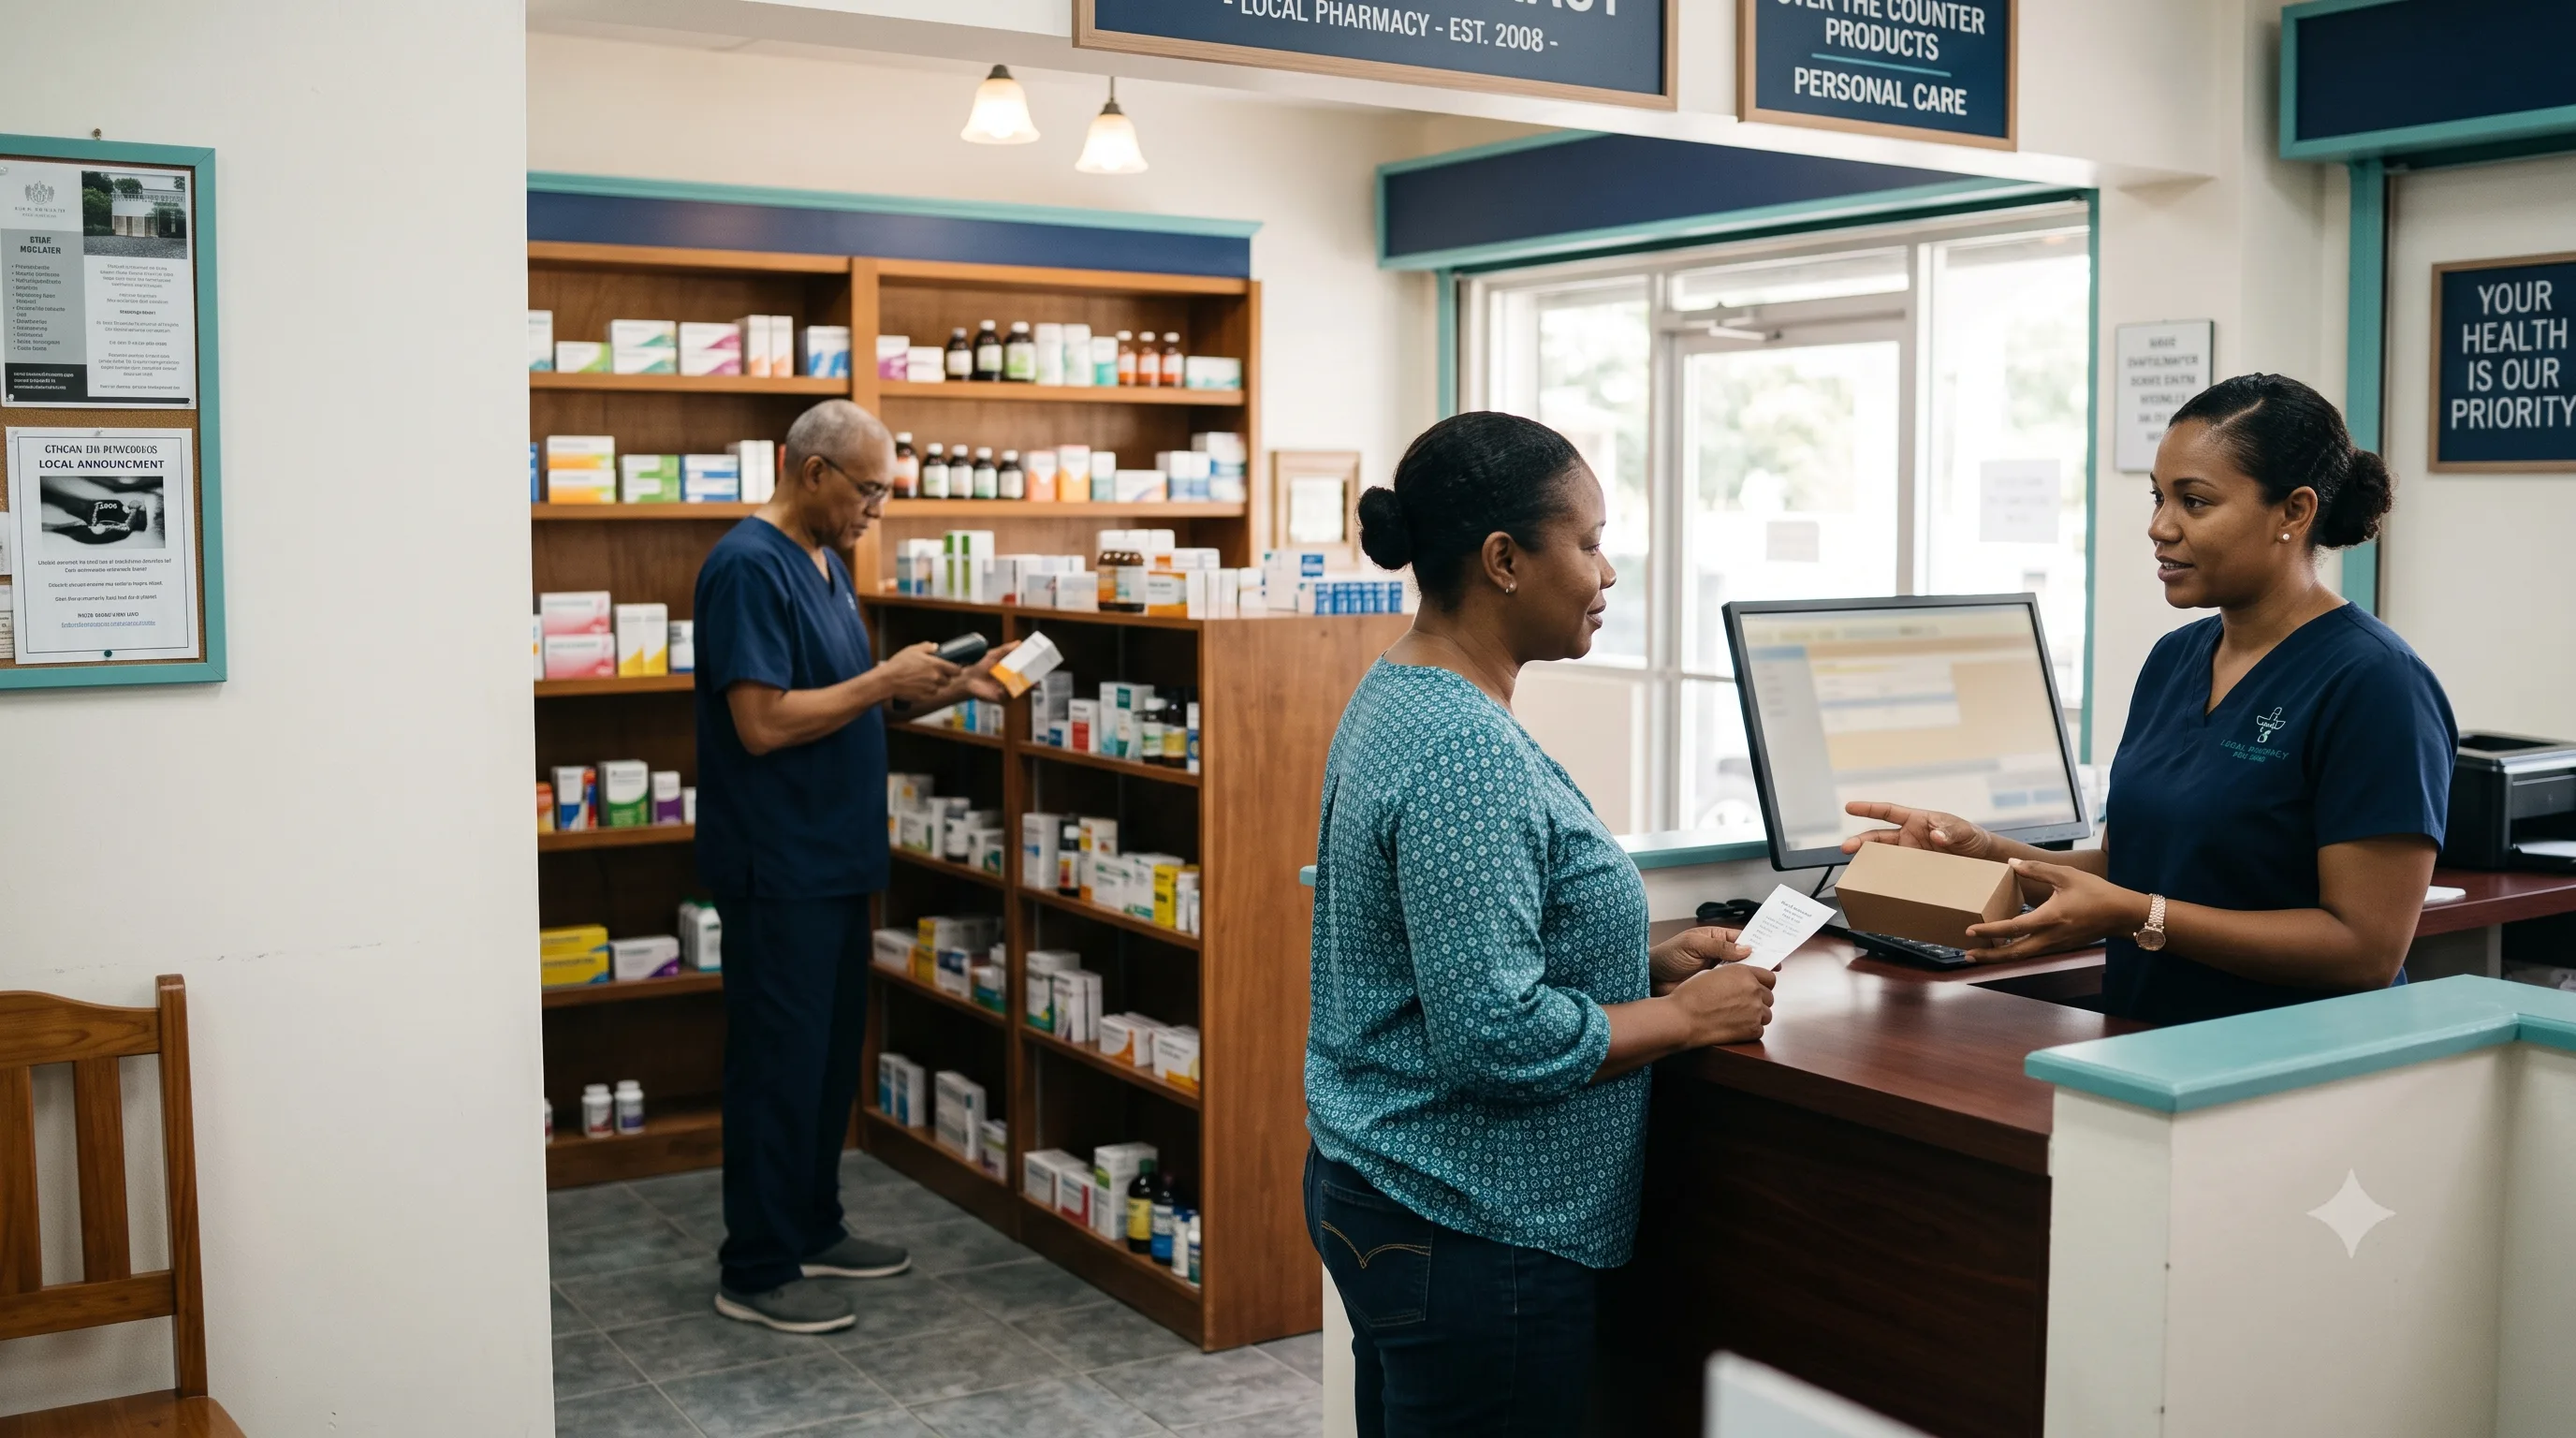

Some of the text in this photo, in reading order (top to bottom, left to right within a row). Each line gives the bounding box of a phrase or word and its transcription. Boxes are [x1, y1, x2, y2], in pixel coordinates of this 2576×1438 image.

[1241, 0, 1309, 22] LOCAL
[1315, 0, 1430, 37] PHARMACY
[1450, 17, 1489, 45] EST.
[1495, 22, 1544, 52] 2008
[1886, 0, 1985, 36] COUNTER
[1825, 17, 1939, 61] PRODUCTS
[1794, 66, 1968, 116] PERSONAL CARE
[2478, 280, 2553, 315] YOUR
[2463, 317, 2568, 354] HEALTH
[2468, 357, 2560, 392] IS OUR
[2452, 394, 2576, 430] PRIORITY
[39, 460, 165, 469] LOCAL ANNOUNCMENT
